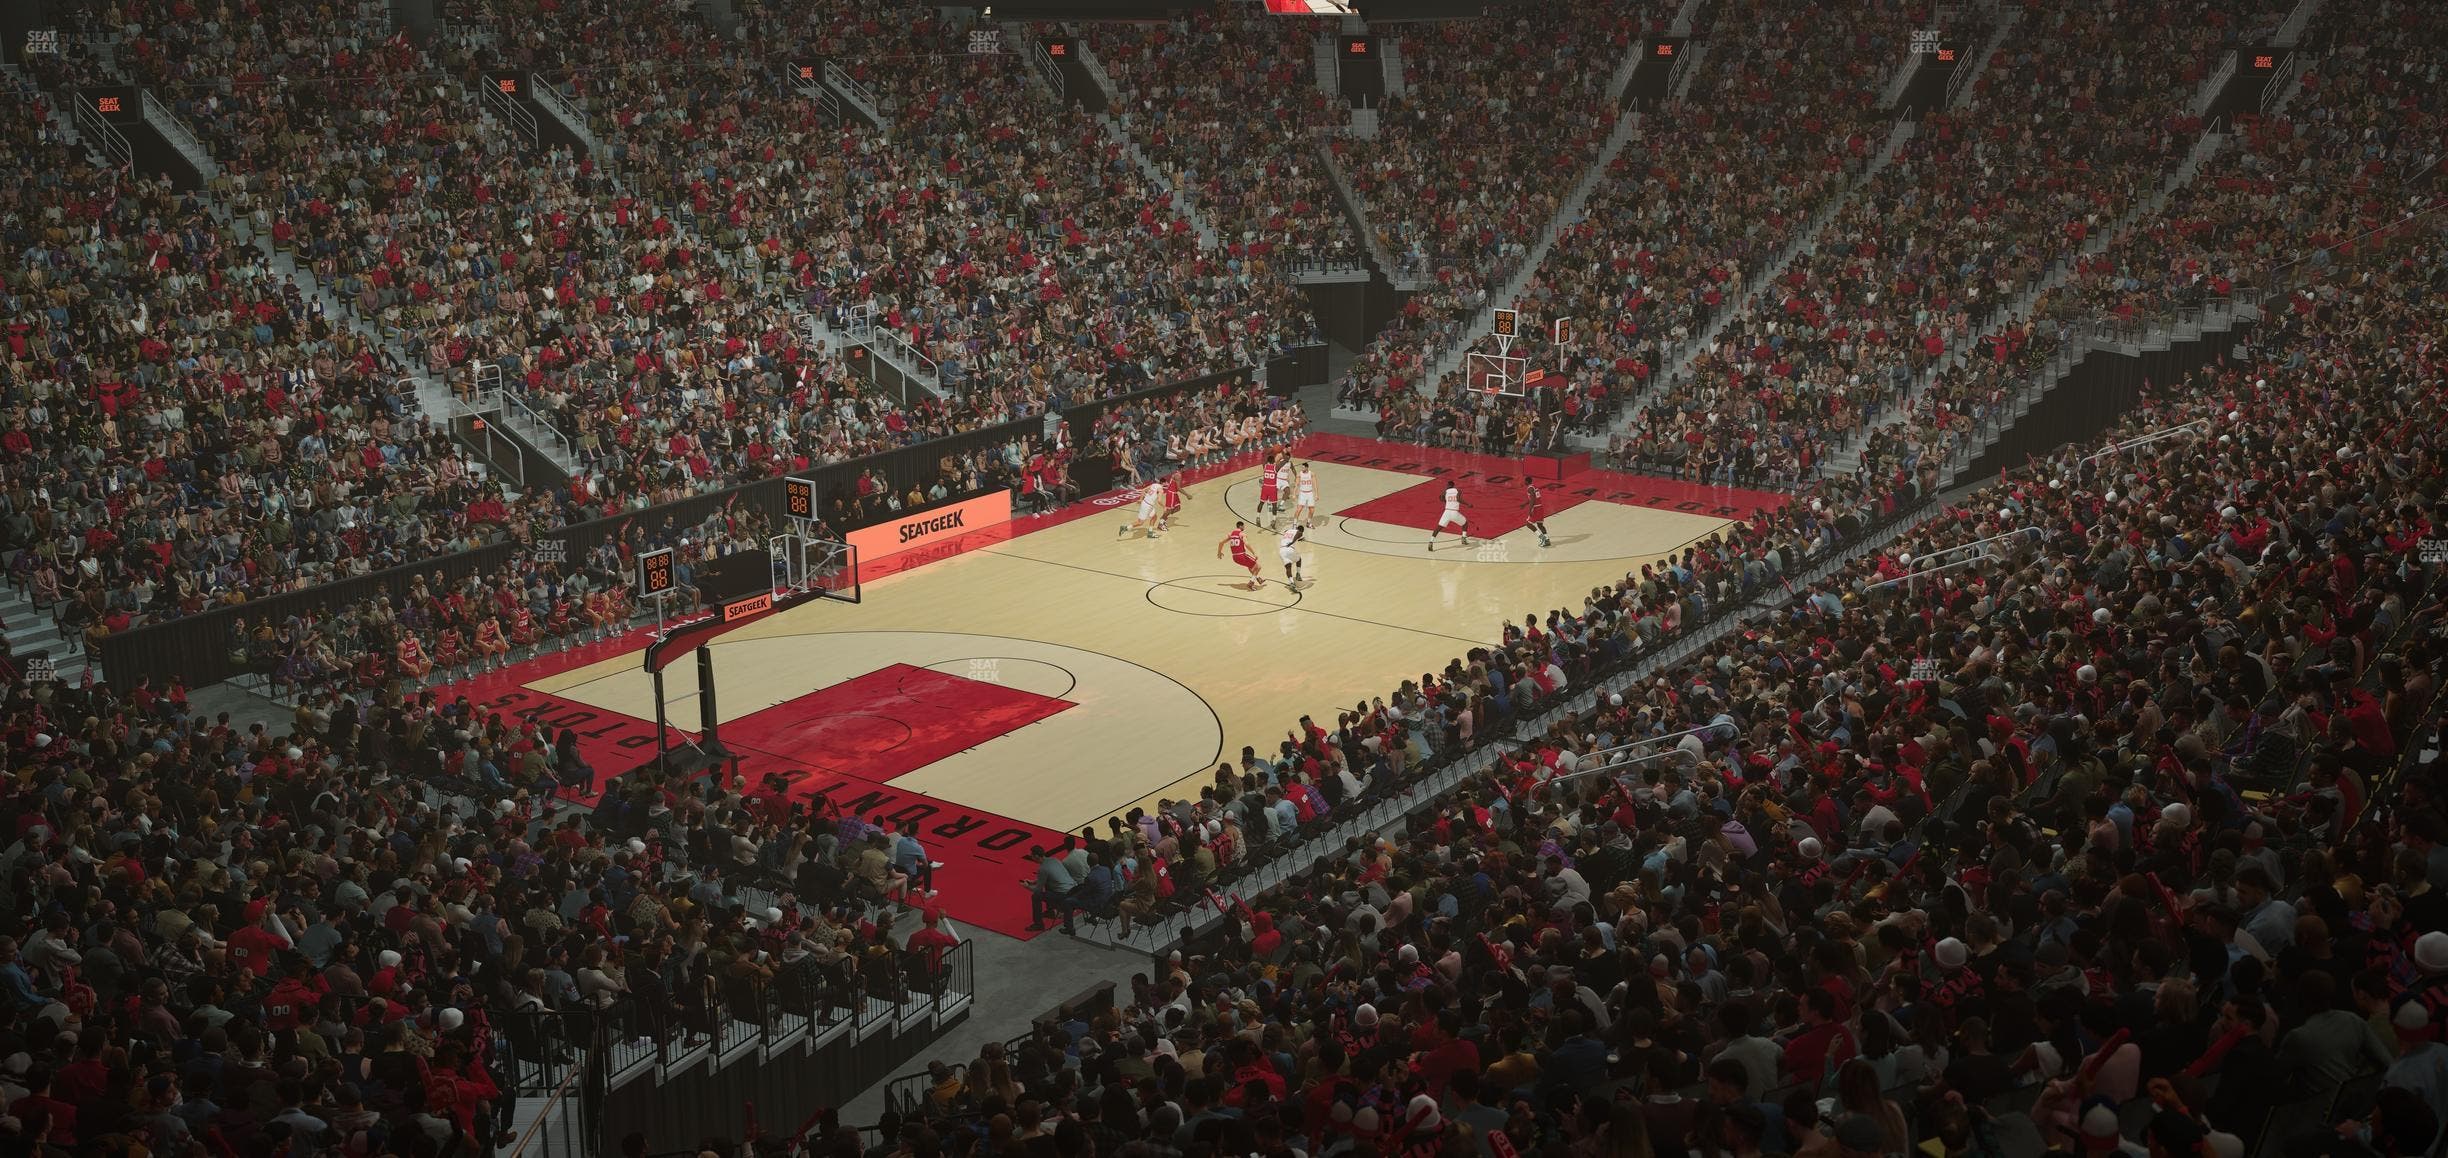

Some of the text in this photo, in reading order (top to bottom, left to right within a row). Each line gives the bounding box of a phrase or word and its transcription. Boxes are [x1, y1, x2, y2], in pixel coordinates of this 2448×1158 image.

[1499, 321, 1510, 333] 88
[1306, 450, 1513, 484] TORONTO
[787, 484, 808, 496] 88 88
[791, 496, 807, 514] 88
[900, 509, 964, 543] SEATGEEK
[647, 554, 668, 570] 88 88
[650, 569, 667, 590] 88
[729, 598, 767, 618] SEATGEEK
[273, 1005, 290, 1016] 00
